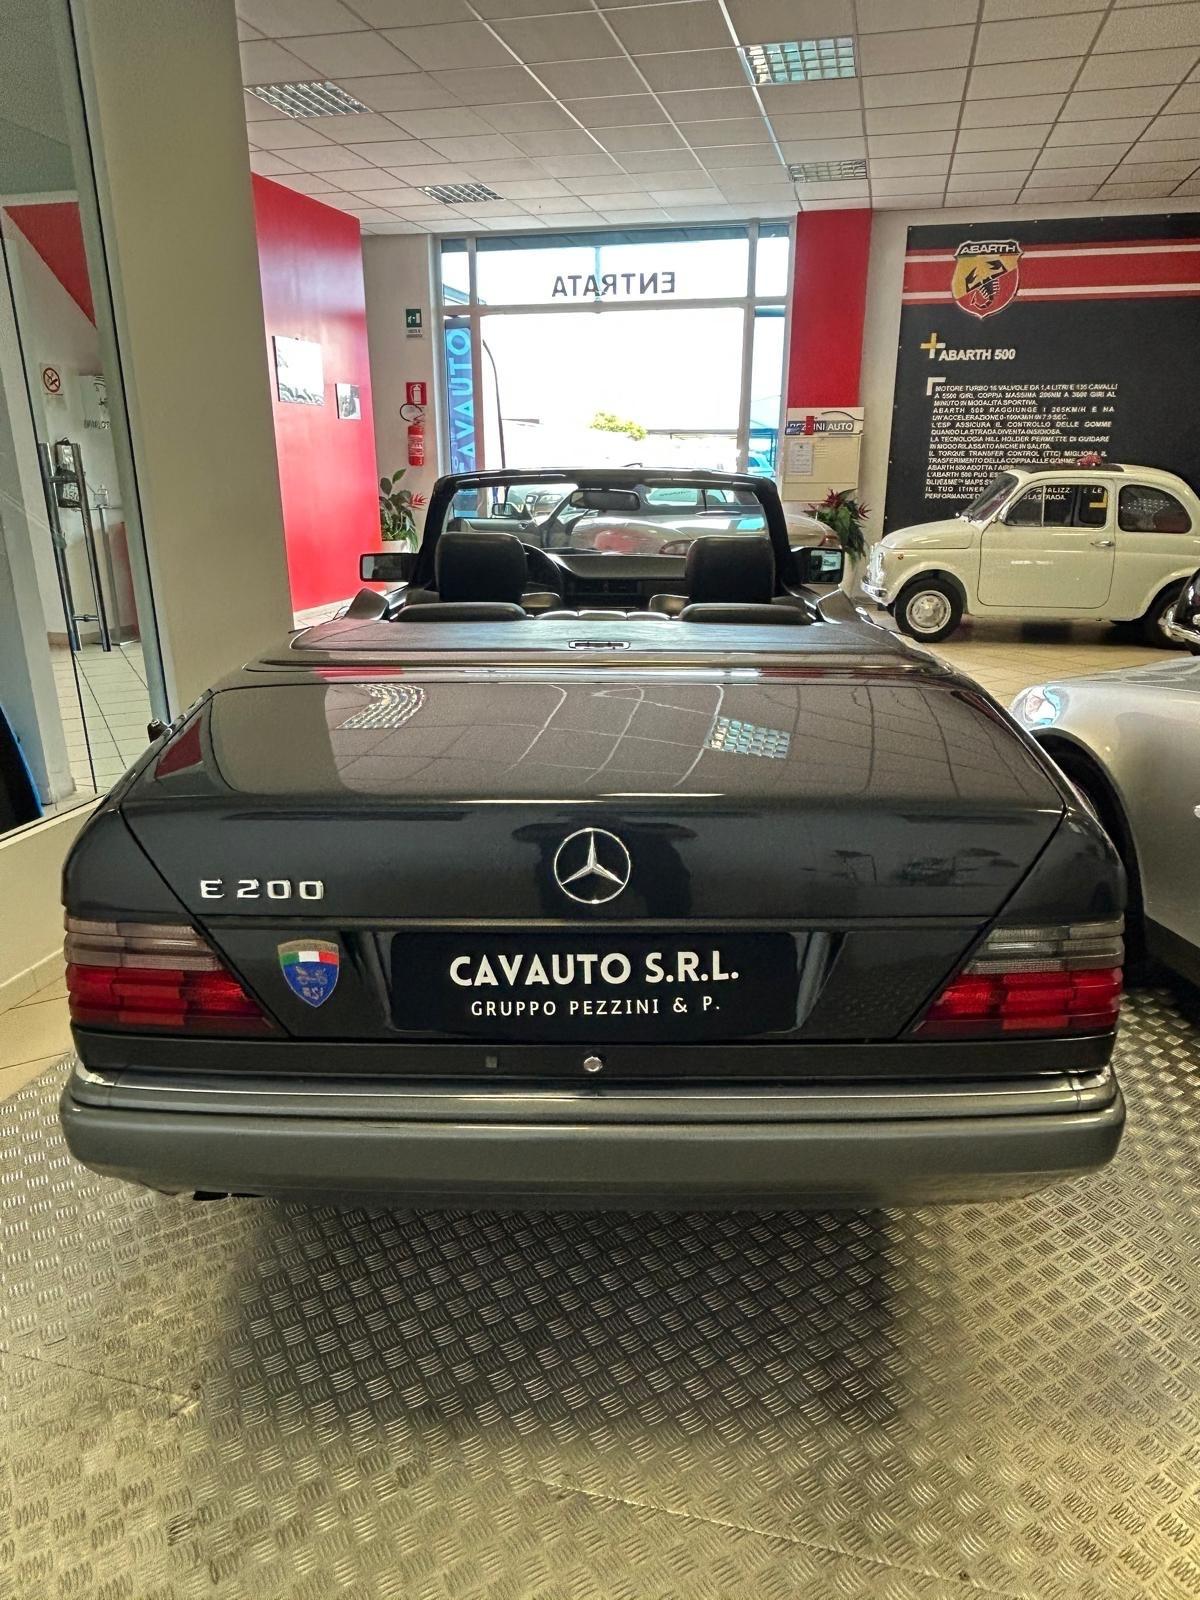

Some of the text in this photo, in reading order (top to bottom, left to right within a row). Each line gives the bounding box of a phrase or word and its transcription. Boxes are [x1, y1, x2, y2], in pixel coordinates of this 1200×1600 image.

[960, 245, 1016, 254] ABARTH
[938, 348, 1016, 361] ABARTH 500
[446, 329, 475, 473] AVAUTO
[827, 422, 853, 431] AUTO
[200, 878, 324, 900] E 200
[450, 950, 739, 986] CAVAUTO S.R.L.
[471, 996, 720, 1016] GRUPPO PEZZINI & P.
